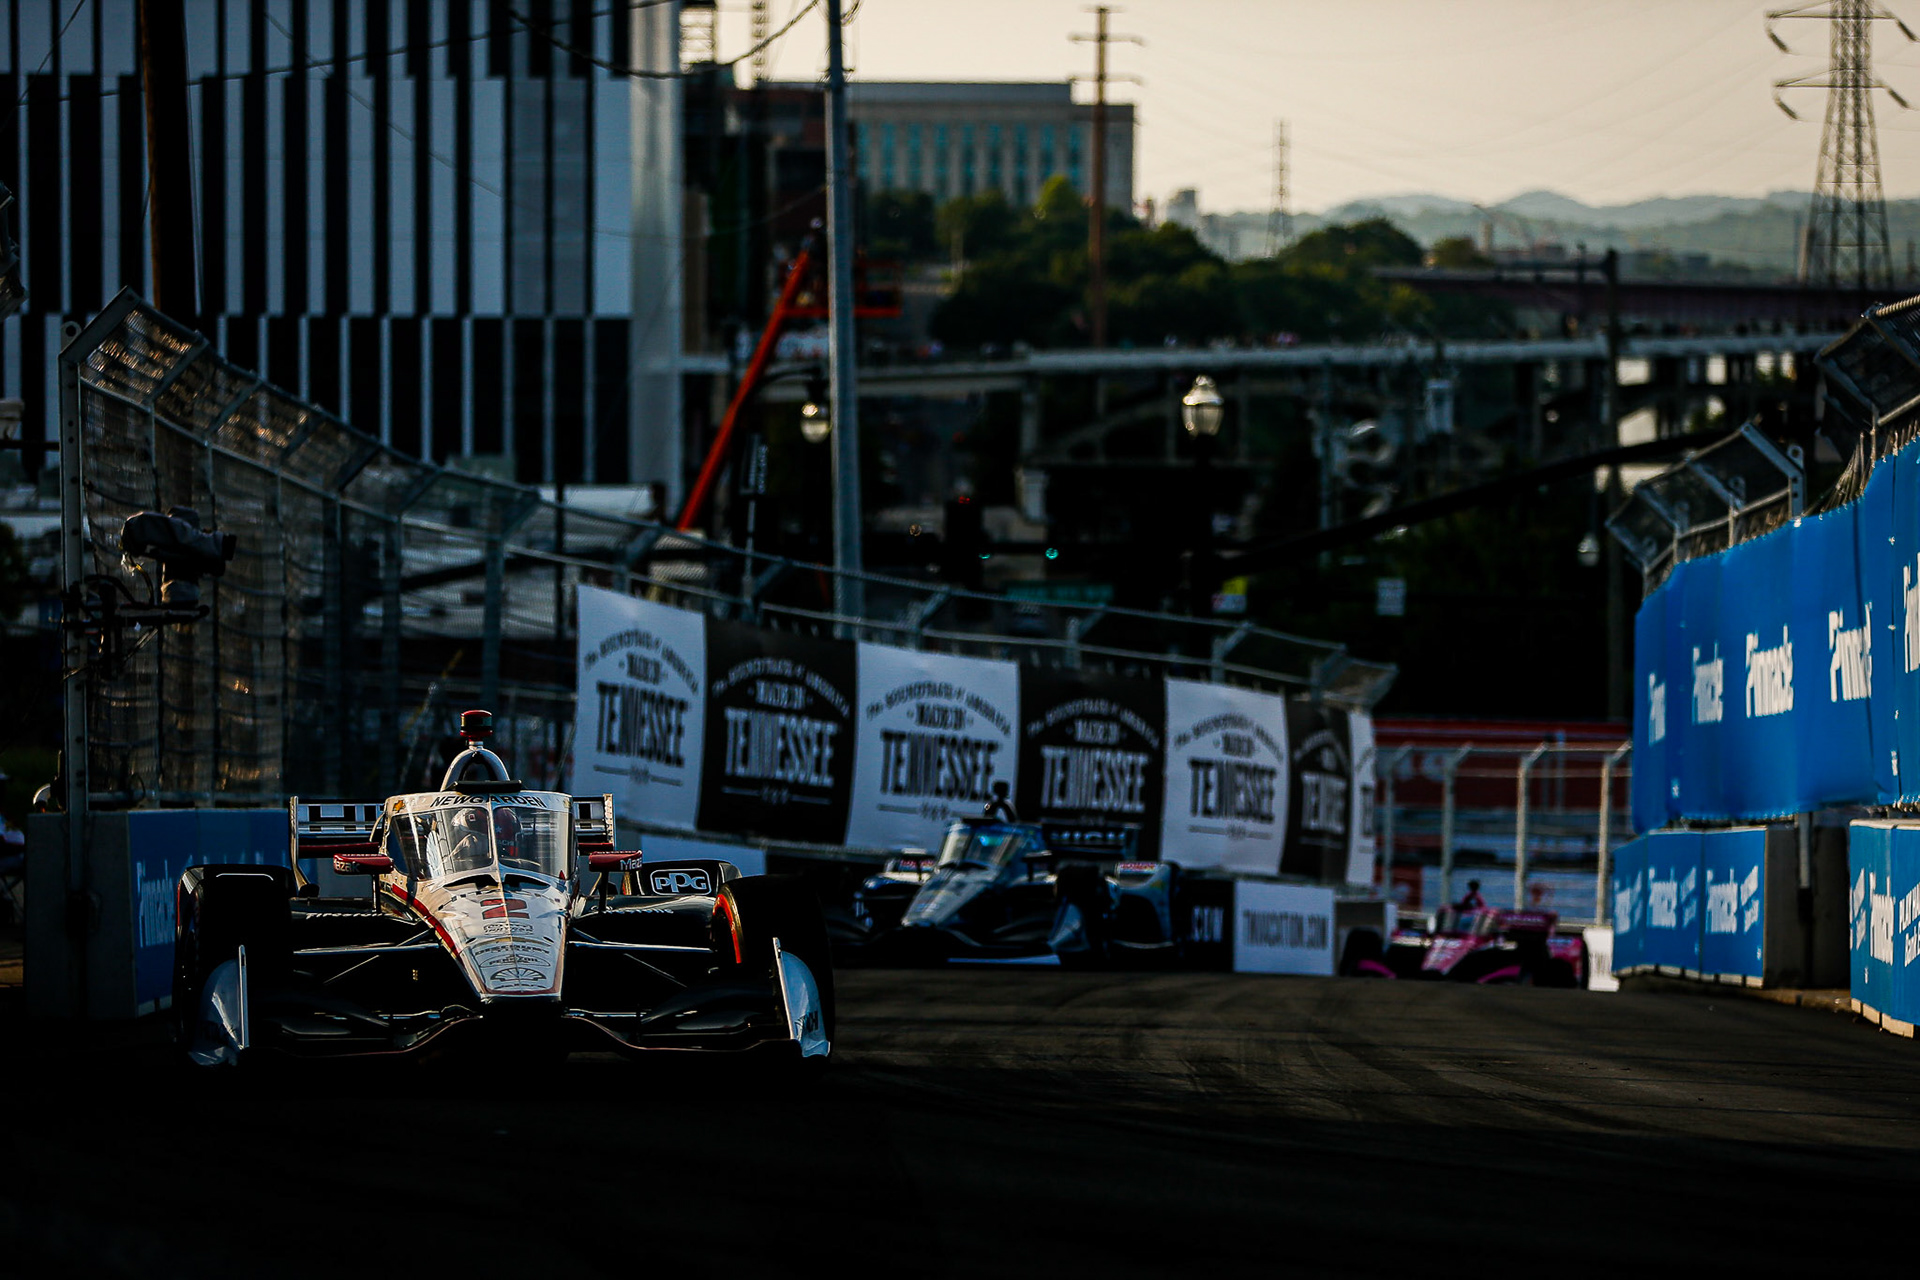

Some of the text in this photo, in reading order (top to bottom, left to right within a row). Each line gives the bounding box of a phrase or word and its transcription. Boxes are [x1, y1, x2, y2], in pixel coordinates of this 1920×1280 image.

[596, 681, 688, 767] TENNESSEE
[723, 706, 839, 788] TENNESSEE
[881, 728, 1000, 801] TENNESSEE
[1040, 743, 1150, 813] TENNESSEE
[430, 794, 547, 808] NEWGARDEN
[655, 872, 707, 893] PPG
